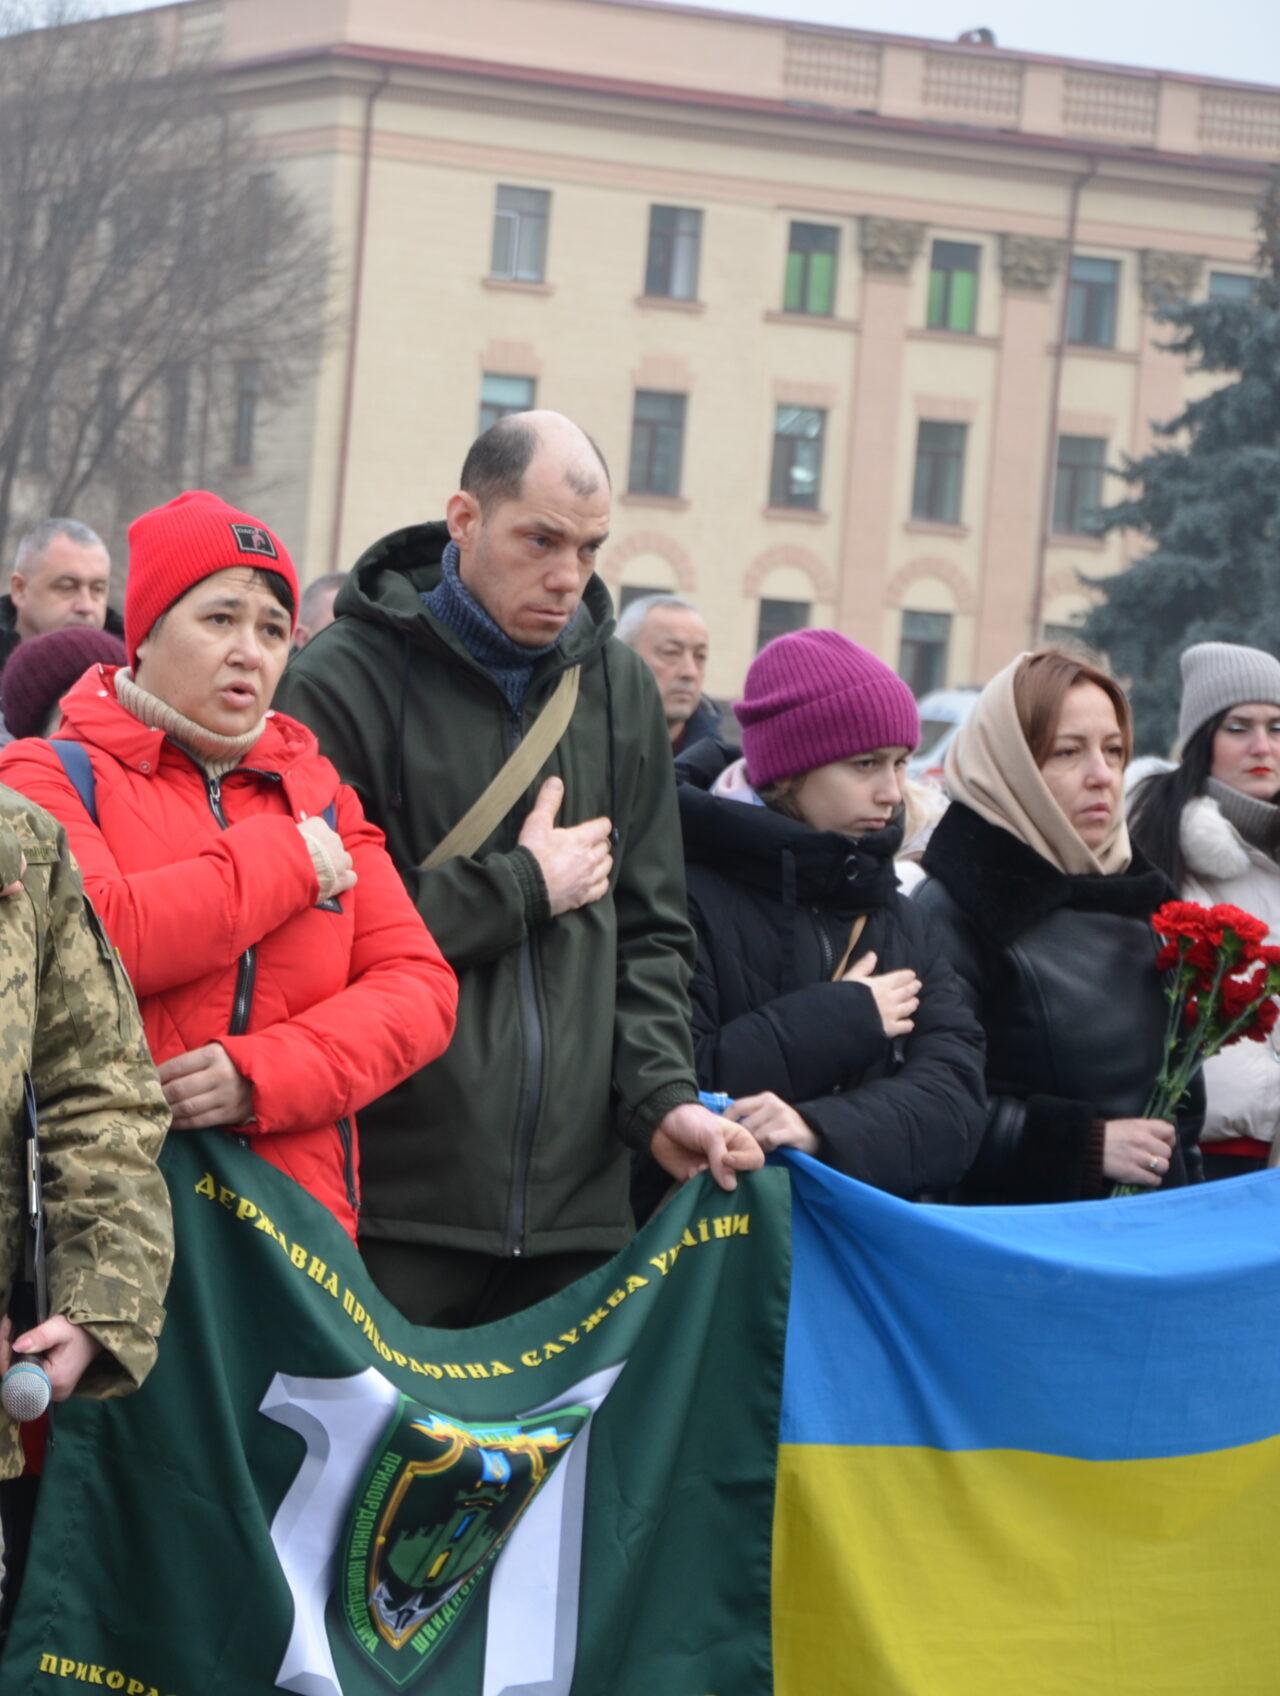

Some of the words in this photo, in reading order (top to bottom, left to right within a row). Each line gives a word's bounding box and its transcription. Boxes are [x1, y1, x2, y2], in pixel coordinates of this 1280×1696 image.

[520, 1274, 650, 1368] СЛУЖБА
[648, 1212, 751, 1276] УАЇНИ
[349, 1450, 403, 1559] ПРИКОРДОННА
[40, 1652, 175, 1696] ПРИКОР
